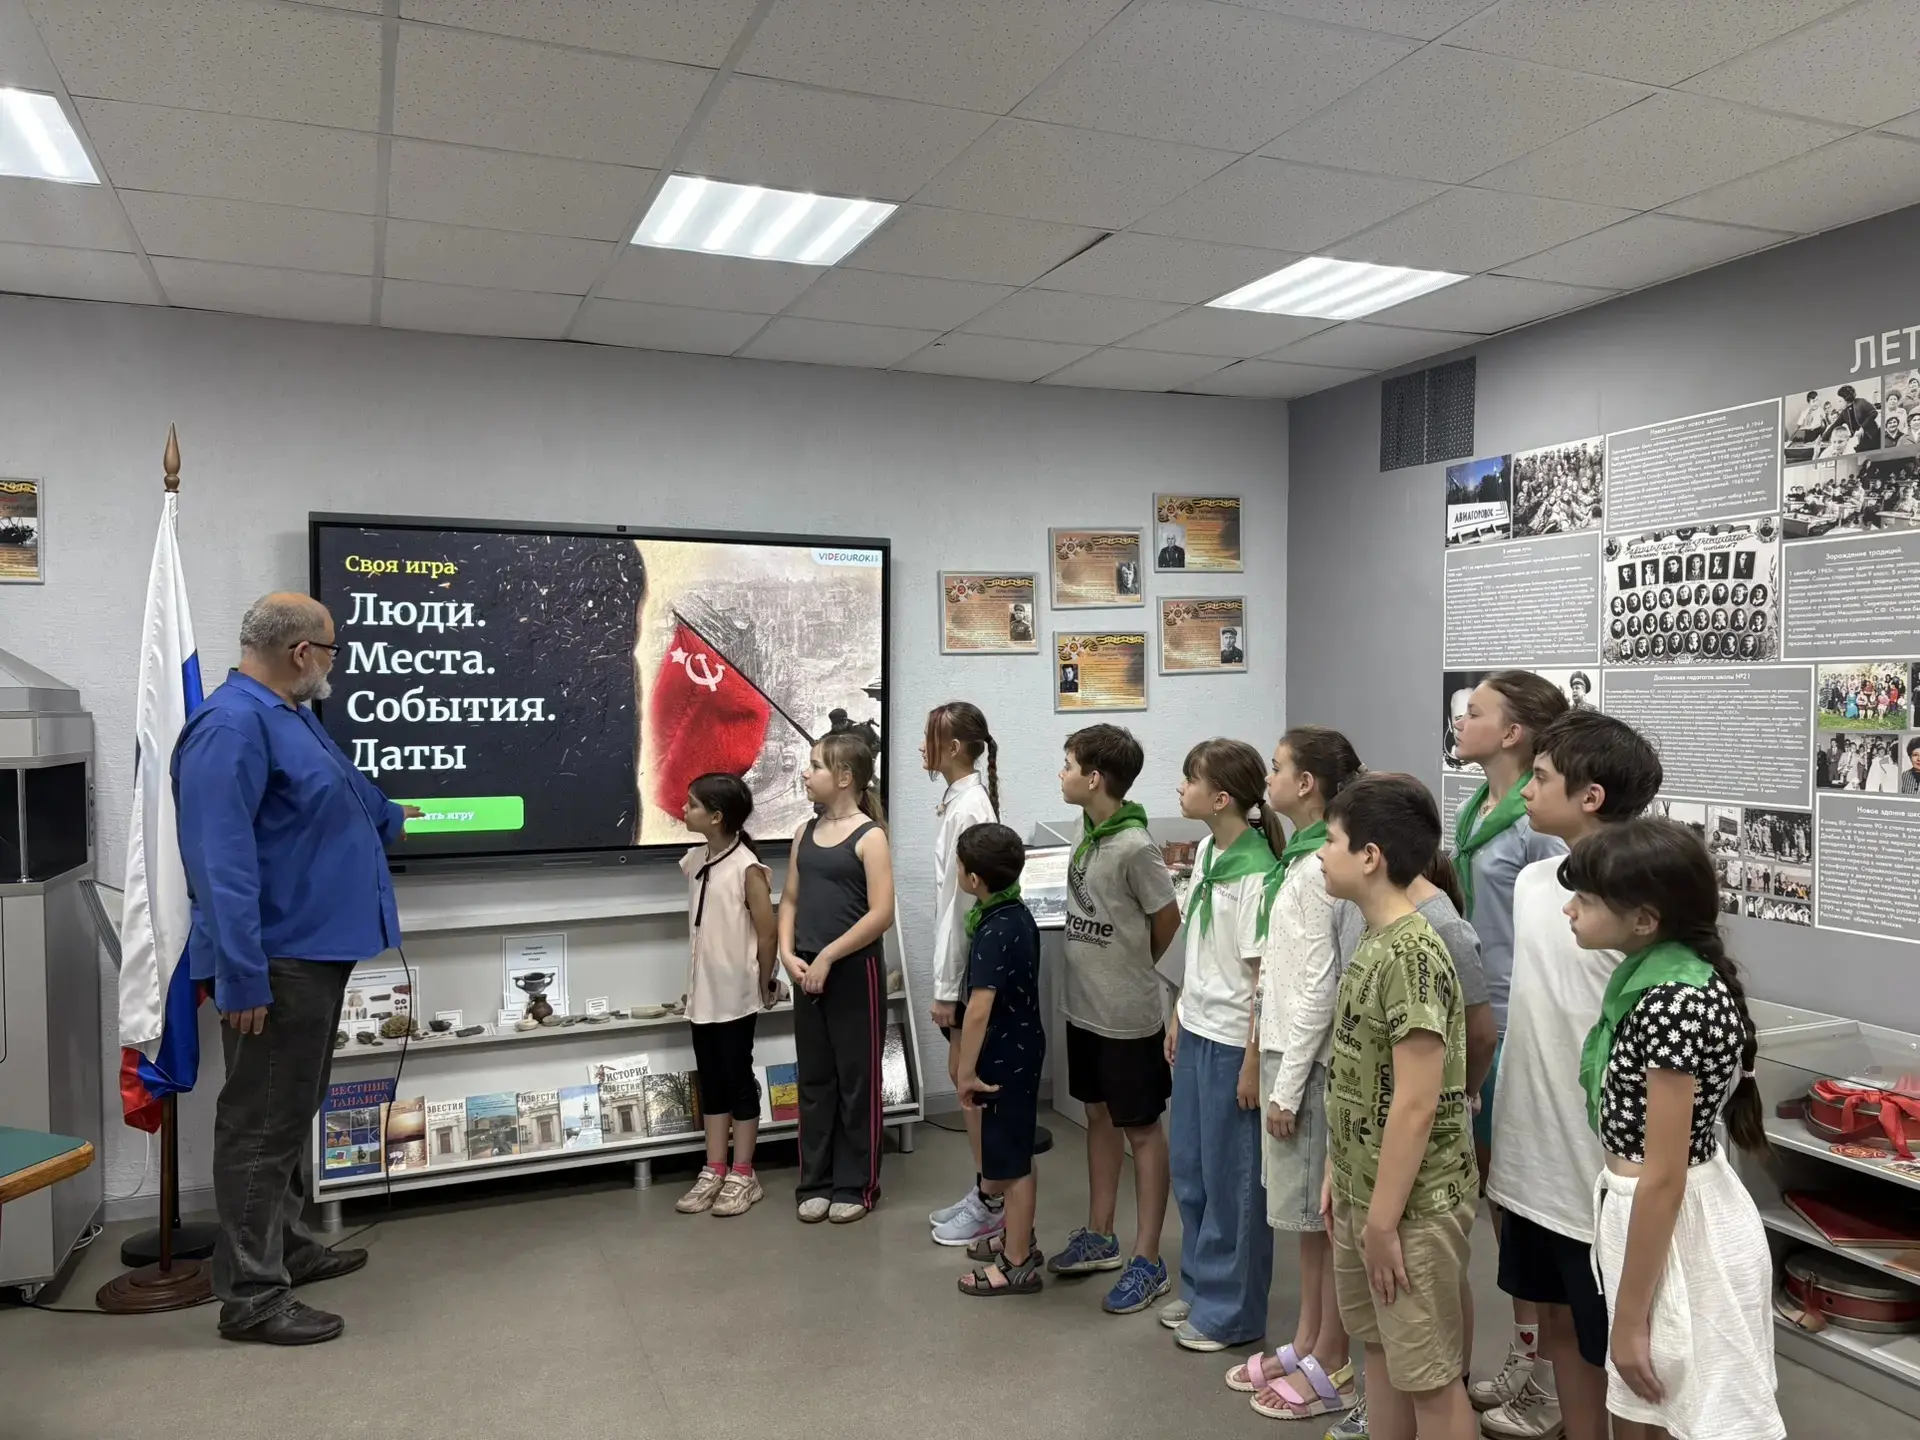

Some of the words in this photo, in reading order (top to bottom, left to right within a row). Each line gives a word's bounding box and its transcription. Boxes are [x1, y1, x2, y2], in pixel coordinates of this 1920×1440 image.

[1850, 325, 1920, 374] ЛЕТ
[345, 555, 398, 573] Своя
[405, 558, 456, 578] игра
[346, 592, 486, 634] Люди.
[346, 641, 496, 674] Места.
[347, 686, 556, 722] События.
[352, 738, 467, 778] Даты
[1856, 806, 1879, 815] Новое
[1417, 952, 1430, 1004] adidas
[332, 1081, 390, 1096] ВЕСТНИК
[606, 1065, 649, 1082] ИСТОРИЯ
[427, 1102, 464, 1114] ЗВЕСТИЯ
